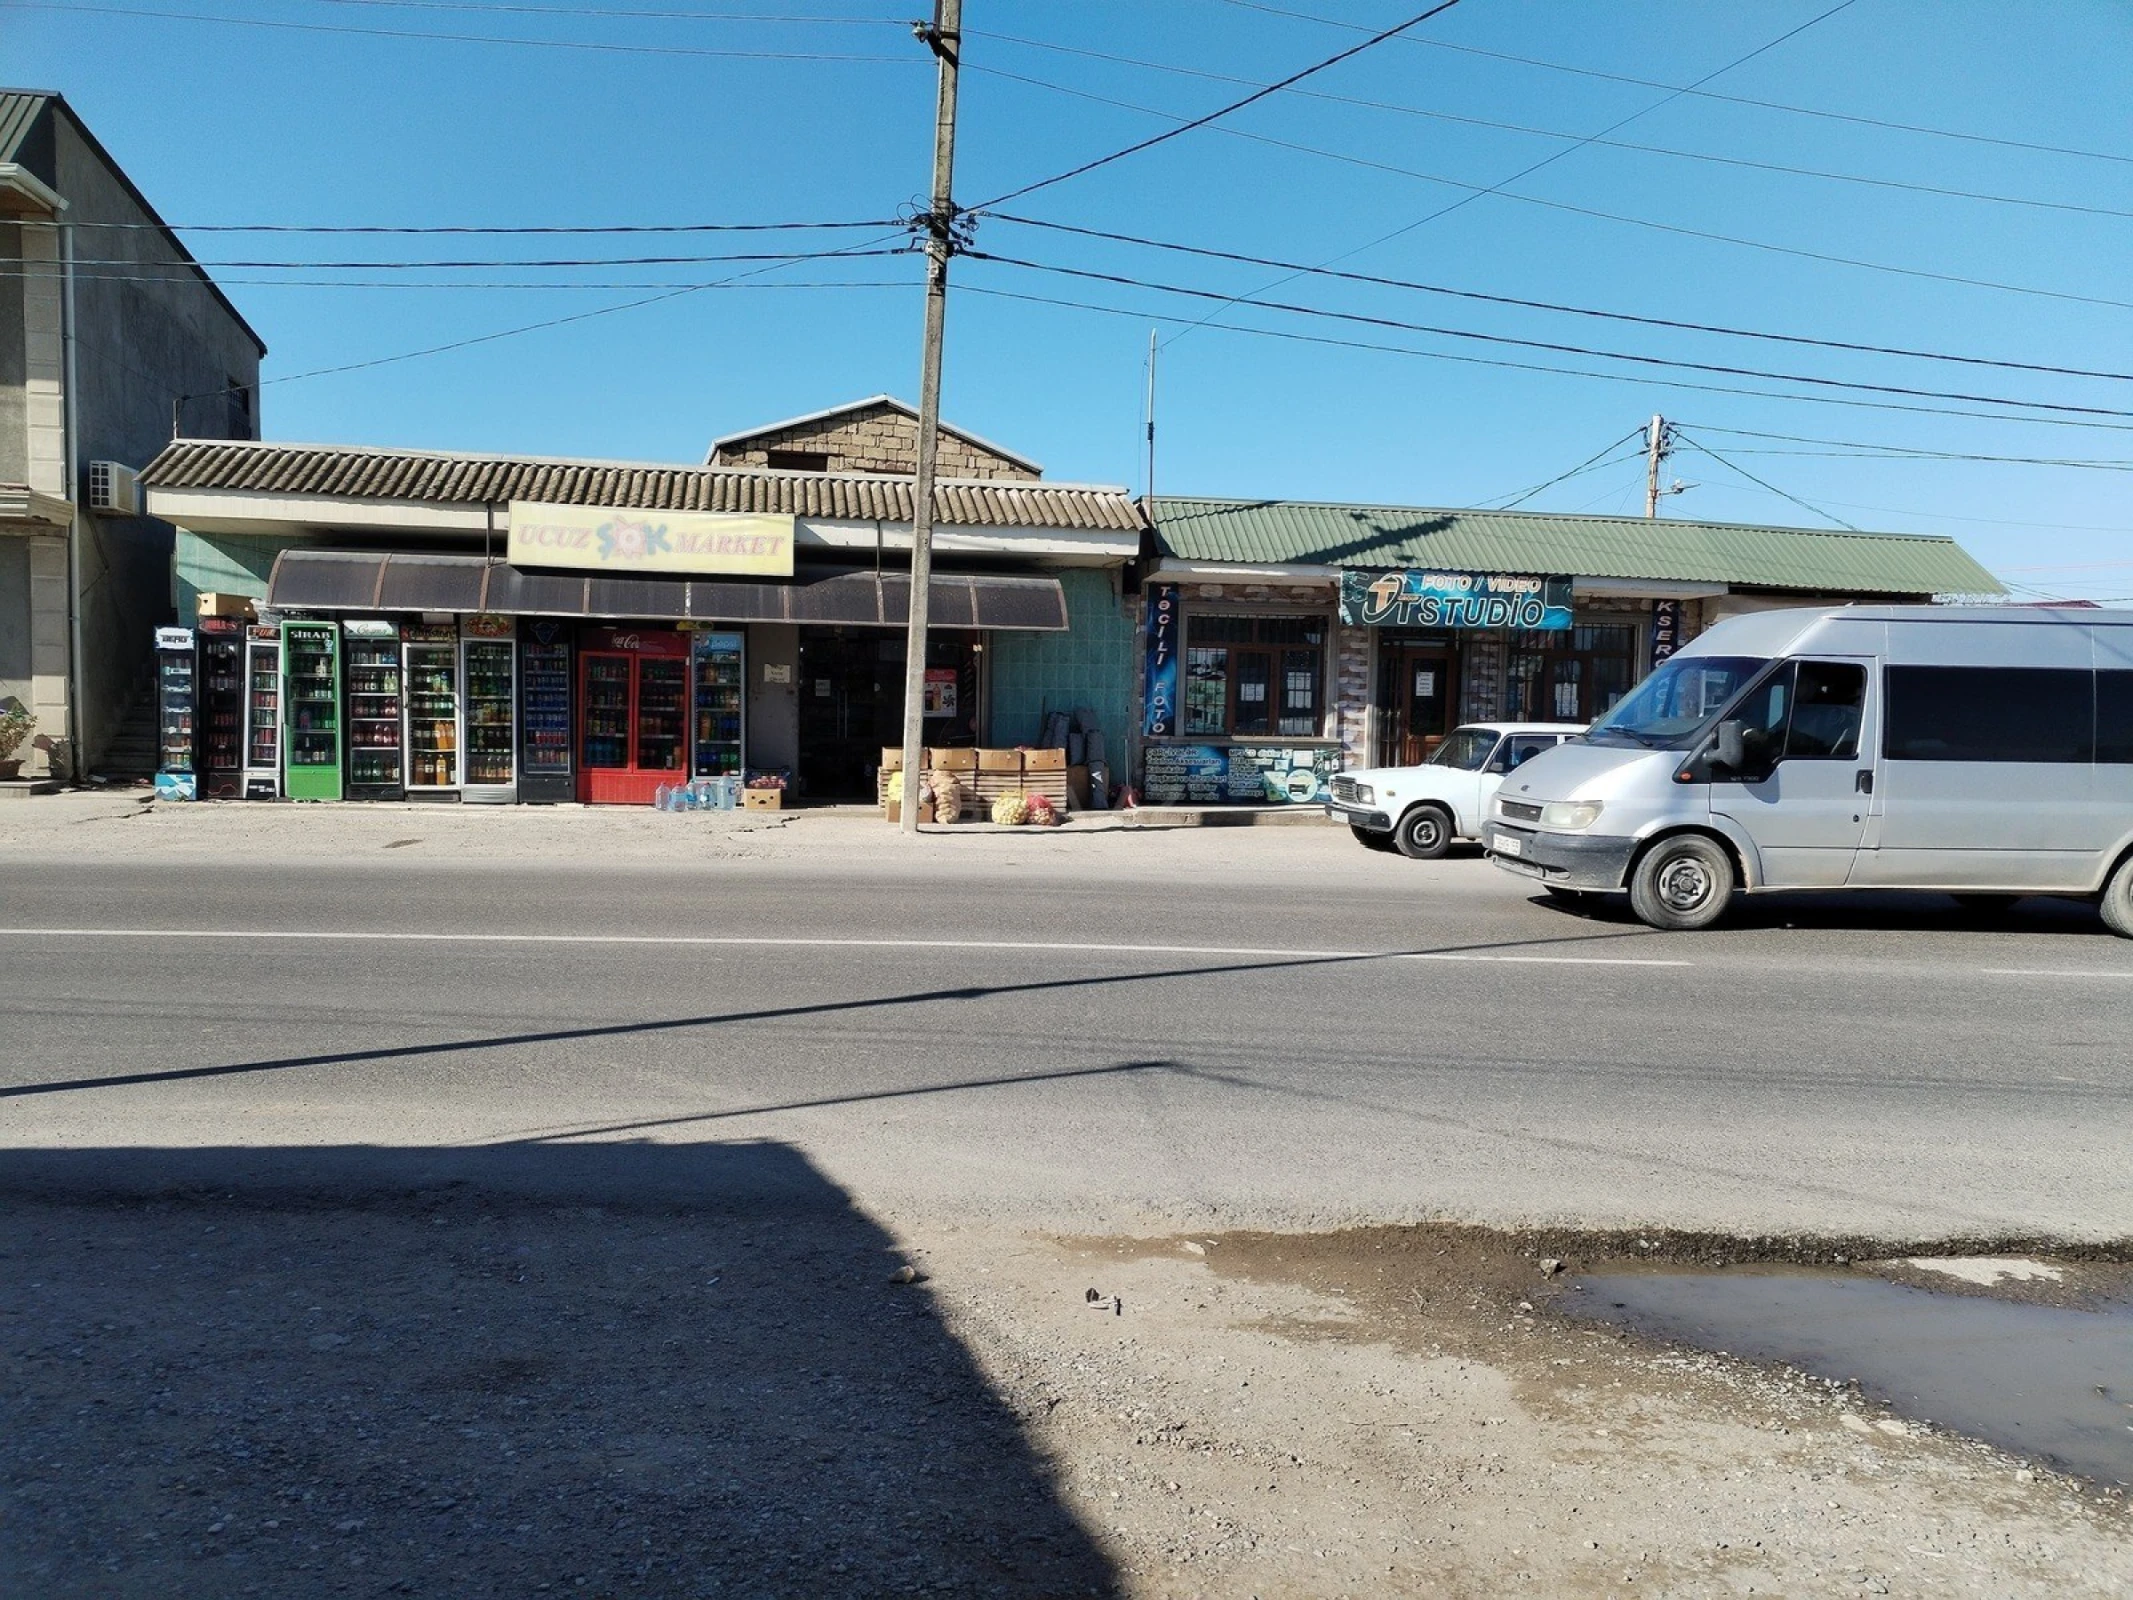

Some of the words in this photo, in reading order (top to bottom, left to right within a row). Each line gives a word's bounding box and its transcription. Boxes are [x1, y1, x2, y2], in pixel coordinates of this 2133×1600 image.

[517, 523, 592, 549] UCUZ
[675, 532, 785, 557] MARKET
[1421, 575, 1472, 591] FOTO
[1486, 573, 1542, 593] VİDEO
[1152, 682, 1166, 733] FOTO
